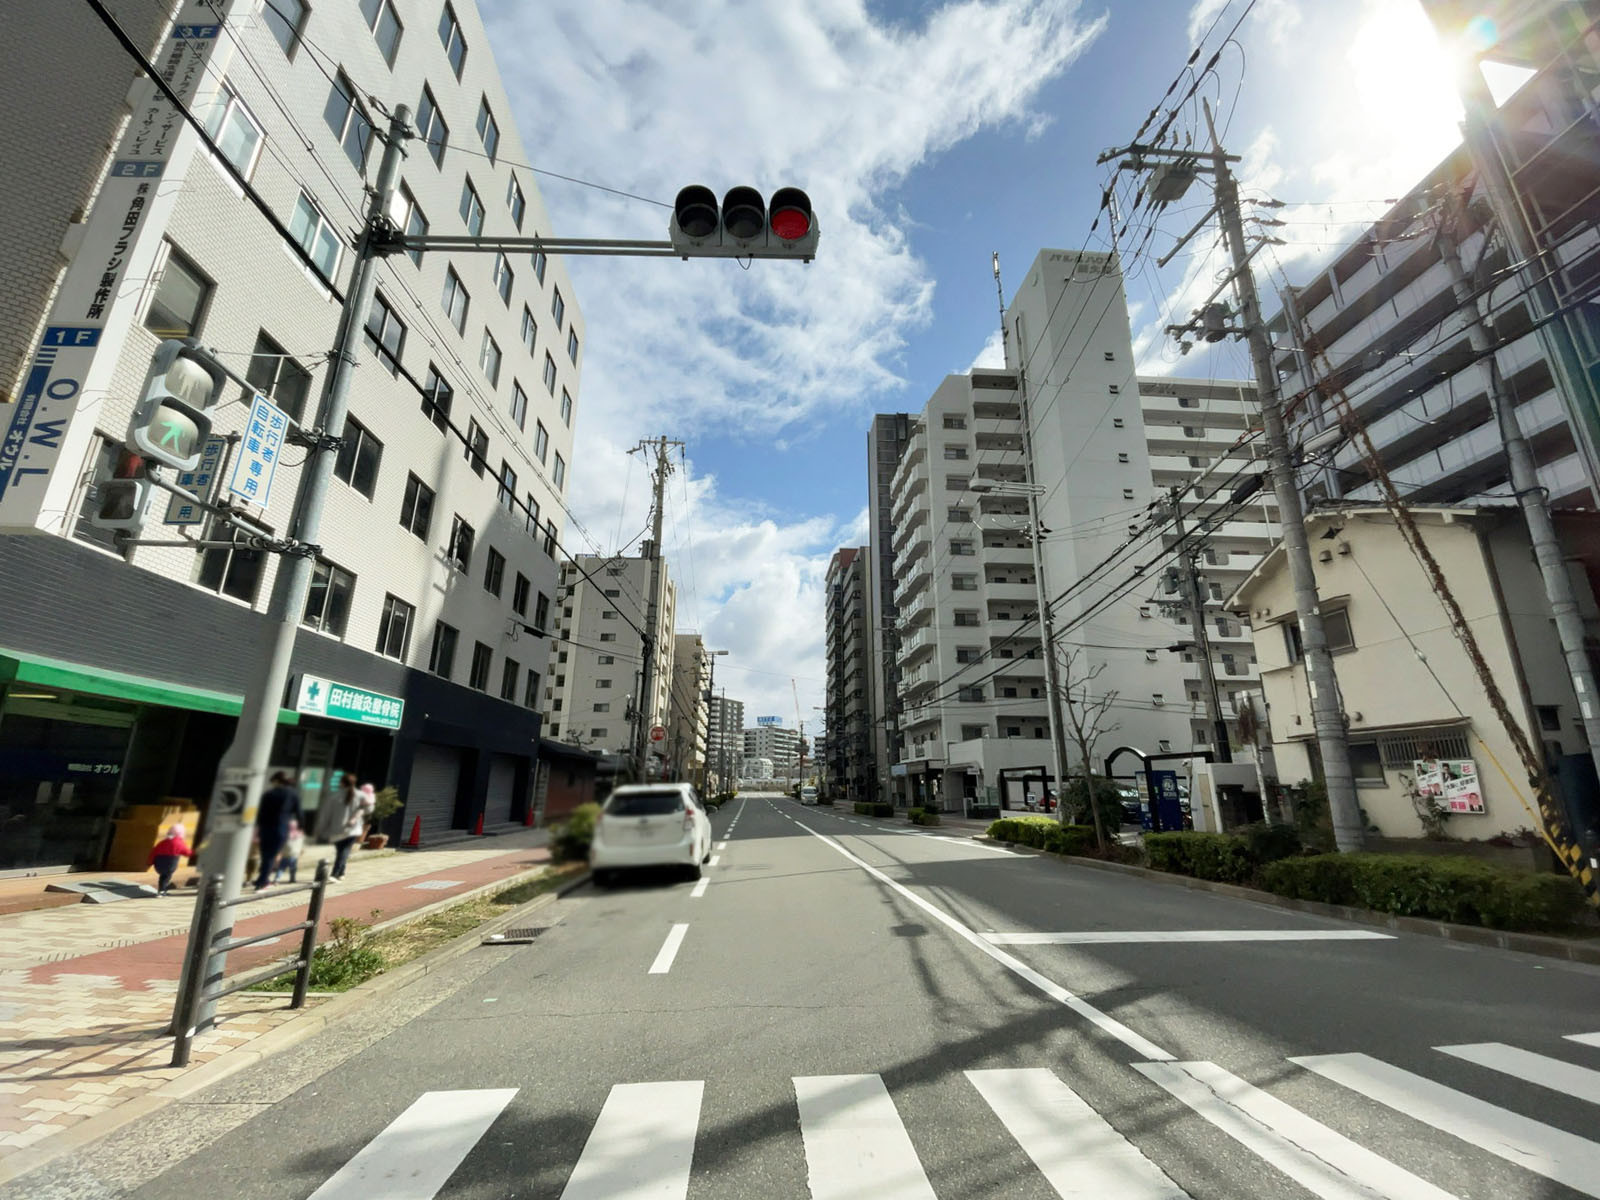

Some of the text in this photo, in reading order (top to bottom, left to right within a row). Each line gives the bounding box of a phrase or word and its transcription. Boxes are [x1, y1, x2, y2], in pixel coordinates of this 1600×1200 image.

[55, 331, 91, 344] 1F
[246, 405, 269, 454] 自転車
[261, 413, 283, 463] 歩行者
[243, 460, 263, 496] 専用
[329, 687, 401, 718] 田村鍼灸整骨院
